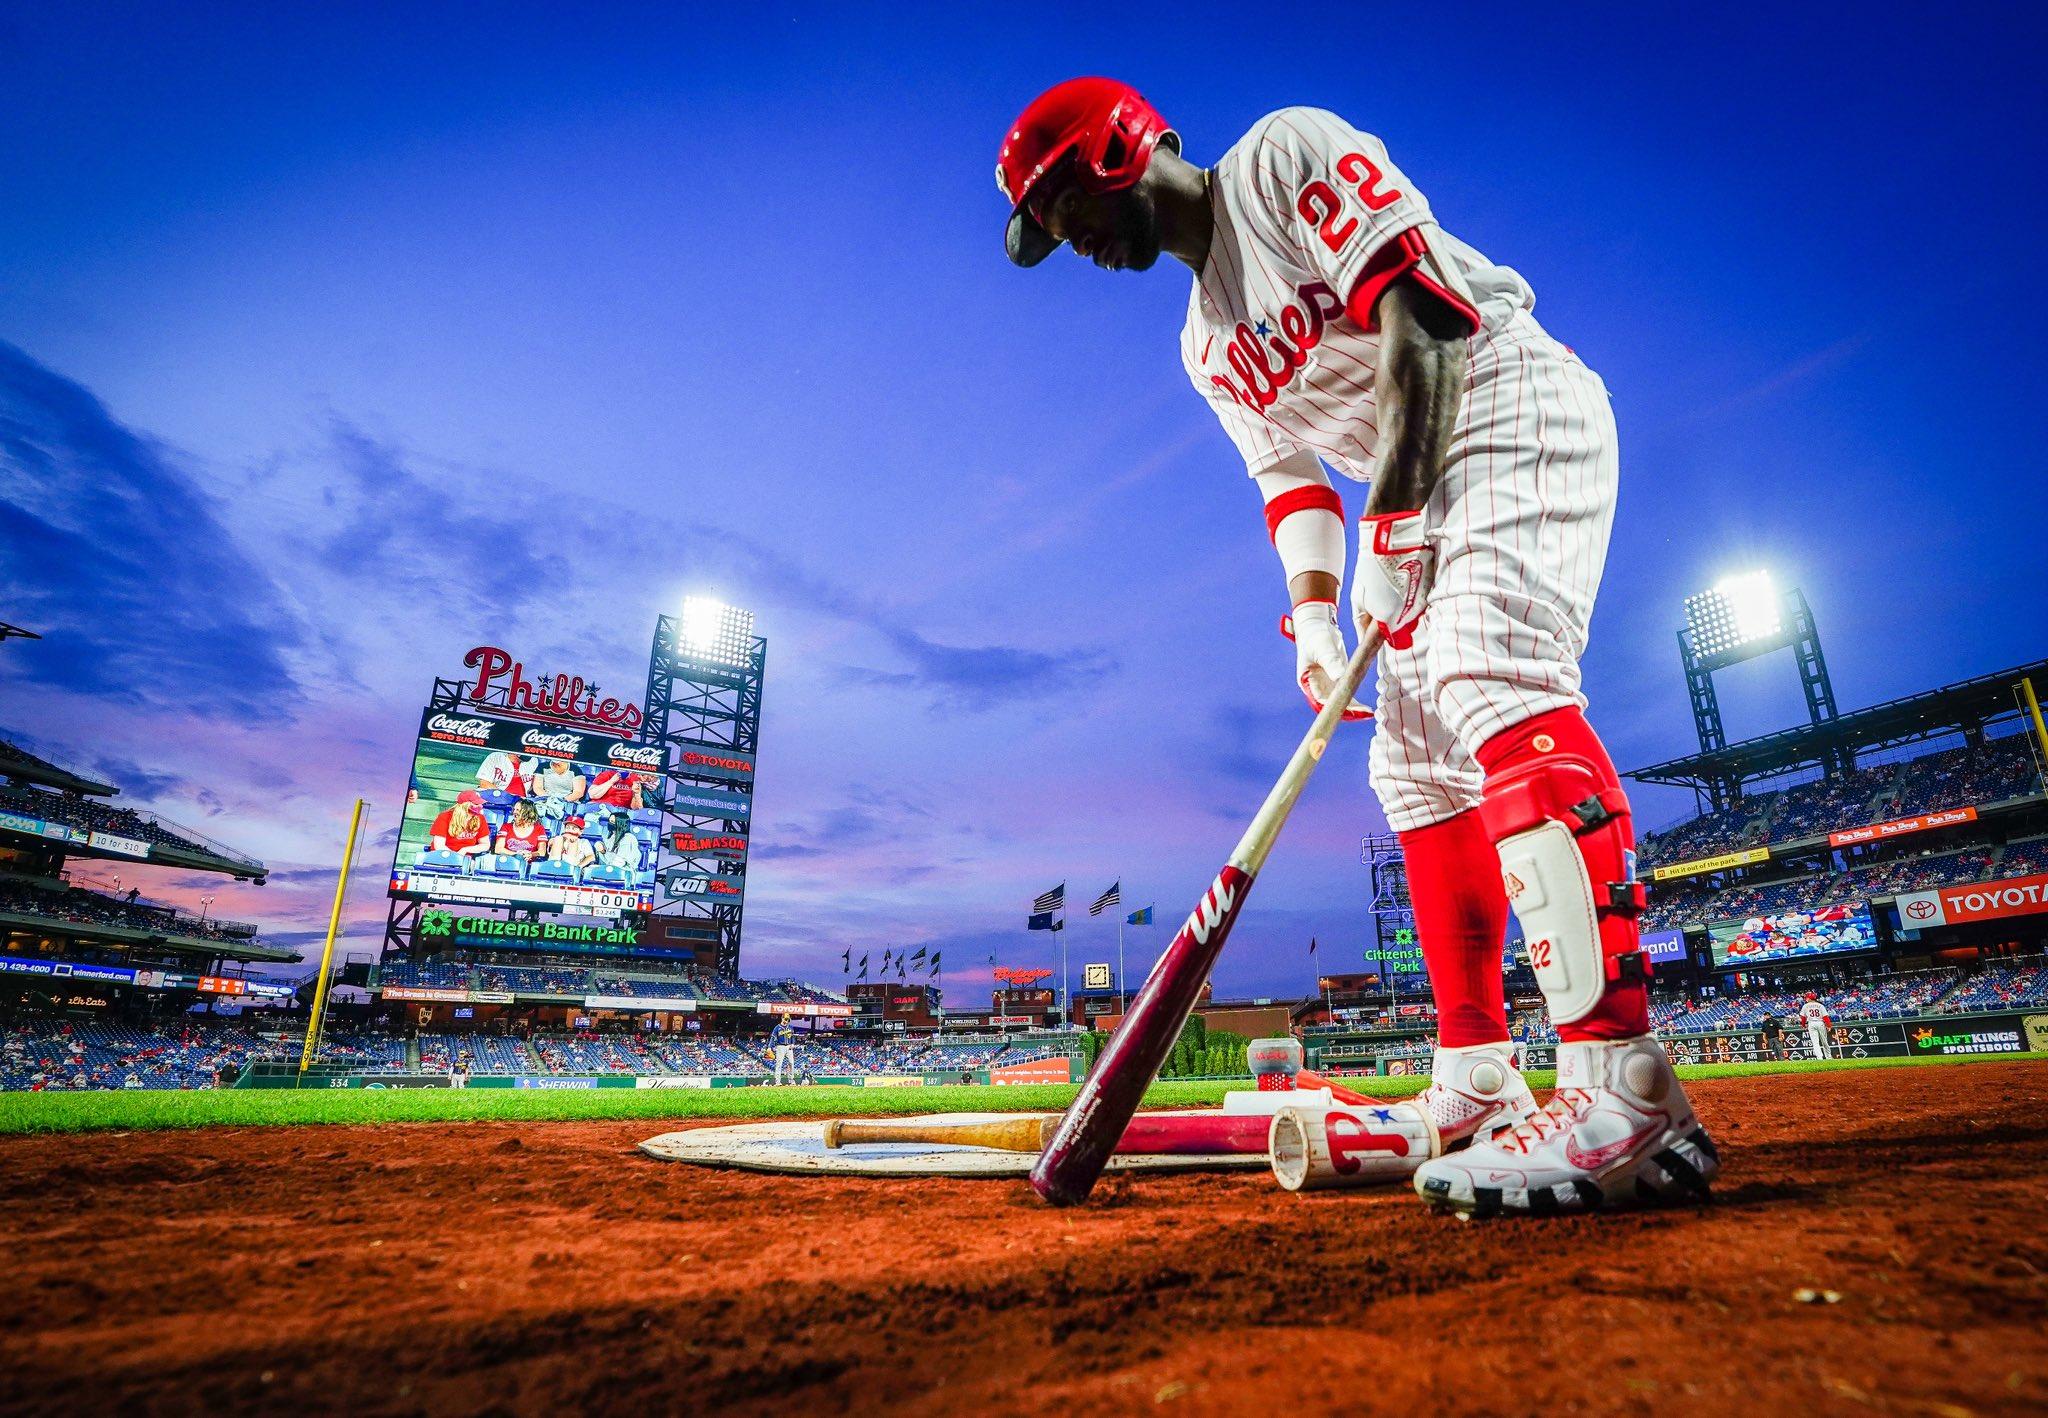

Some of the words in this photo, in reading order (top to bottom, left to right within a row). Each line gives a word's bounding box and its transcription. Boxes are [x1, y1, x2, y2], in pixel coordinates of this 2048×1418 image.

[1297, 152, 1402, 255] 22
[463, 646, 644, 728] Phillies
[455, 736, 486, 746] SUGAR
[548, 750, 575, 760] SUGAR
[632, 763, 658, 772] SUGAR
[700, 754, 752, 772] TOYOTA
[109, 840, 121, 848] for
[1670, 867, 1680, 875] Hit
[1680, 866, 1686, 874] it
[1707, 861, 1719, 869] the
[669, 877, 708, 894] KDI
[601, 894, 610, 906] 0
[614, 895, 622, 907] 0
[627, 896, 635, 908] 0
[456, 916, 540, 938] Citizens
[543, 922, 593, 941] Bank
[596, 925, 638, 944] Park
[1365, 948, 1414, 961] Citizens
[1531, 939, 1551, 970] 22
[1393, 960, 1420, 972] Park
[773, 1005, 805, 1013] TOYOTA
[1809, 1009, 1820, 1018] 38
[1512, 1028, 1522, 1037] 20
[1866, 1026, 1877, 1034] PIT
[1688, 1039, 1699, 1047] LAD
[1741, 1035, 1756, 1043] CWS
[1869, 1035, 1879, 1043] SD
[1918, 1031, 2019, 1048] DRAFTKINGS
[1943, 1042, 2020, 1054] SPORTSBOOK
[1747, 1052, 1758, 1060] ARI
[329, 1078, 349, 1088] 334
[538, 1078, 591, 1089] SHERWIN
